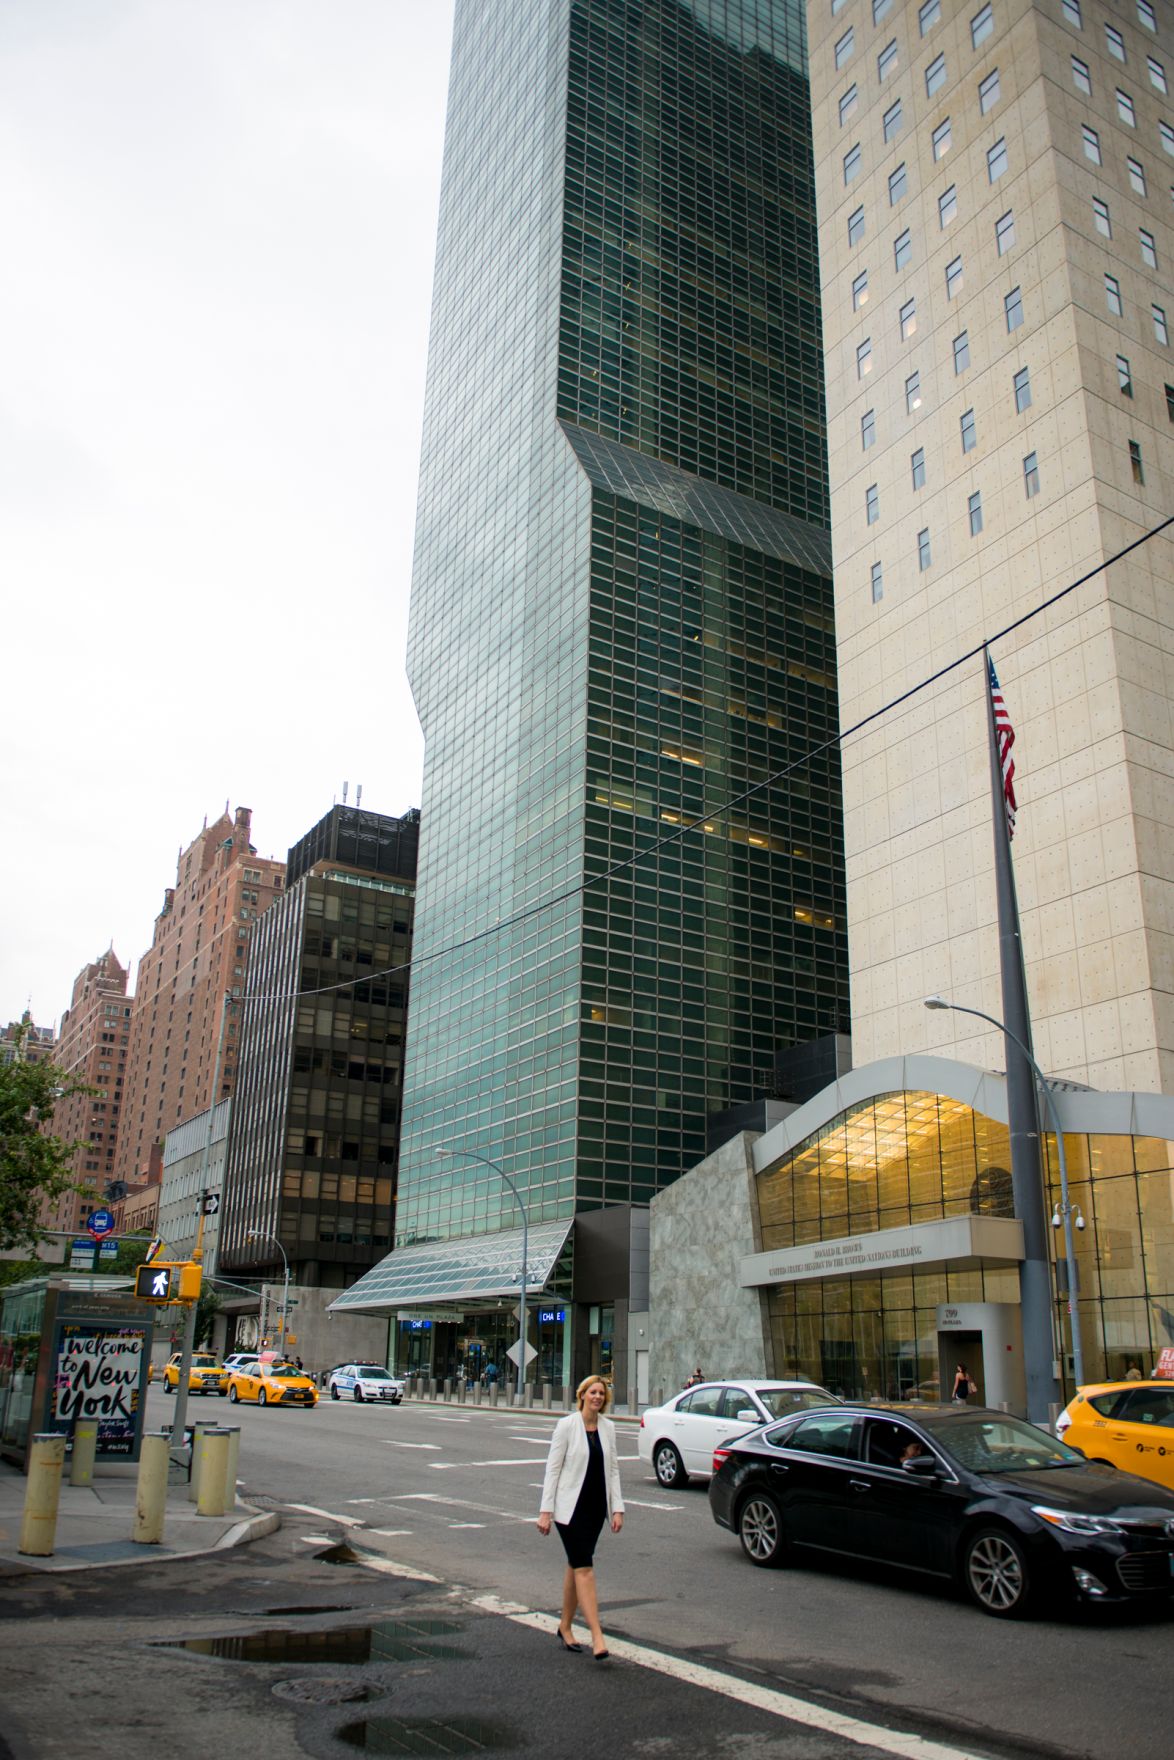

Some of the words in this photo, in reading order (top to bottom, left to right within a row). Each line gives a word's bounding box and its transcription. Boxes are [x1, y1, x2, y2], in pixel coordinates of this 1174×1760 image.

[542, 1312, 561, 1321] CHAE
[67, 1336, 139, 1357] welcome
[60, 1355, 78, 1373] to
[72, 1356, 137, 1391] New
[59, 1385, 131, 1420] York
